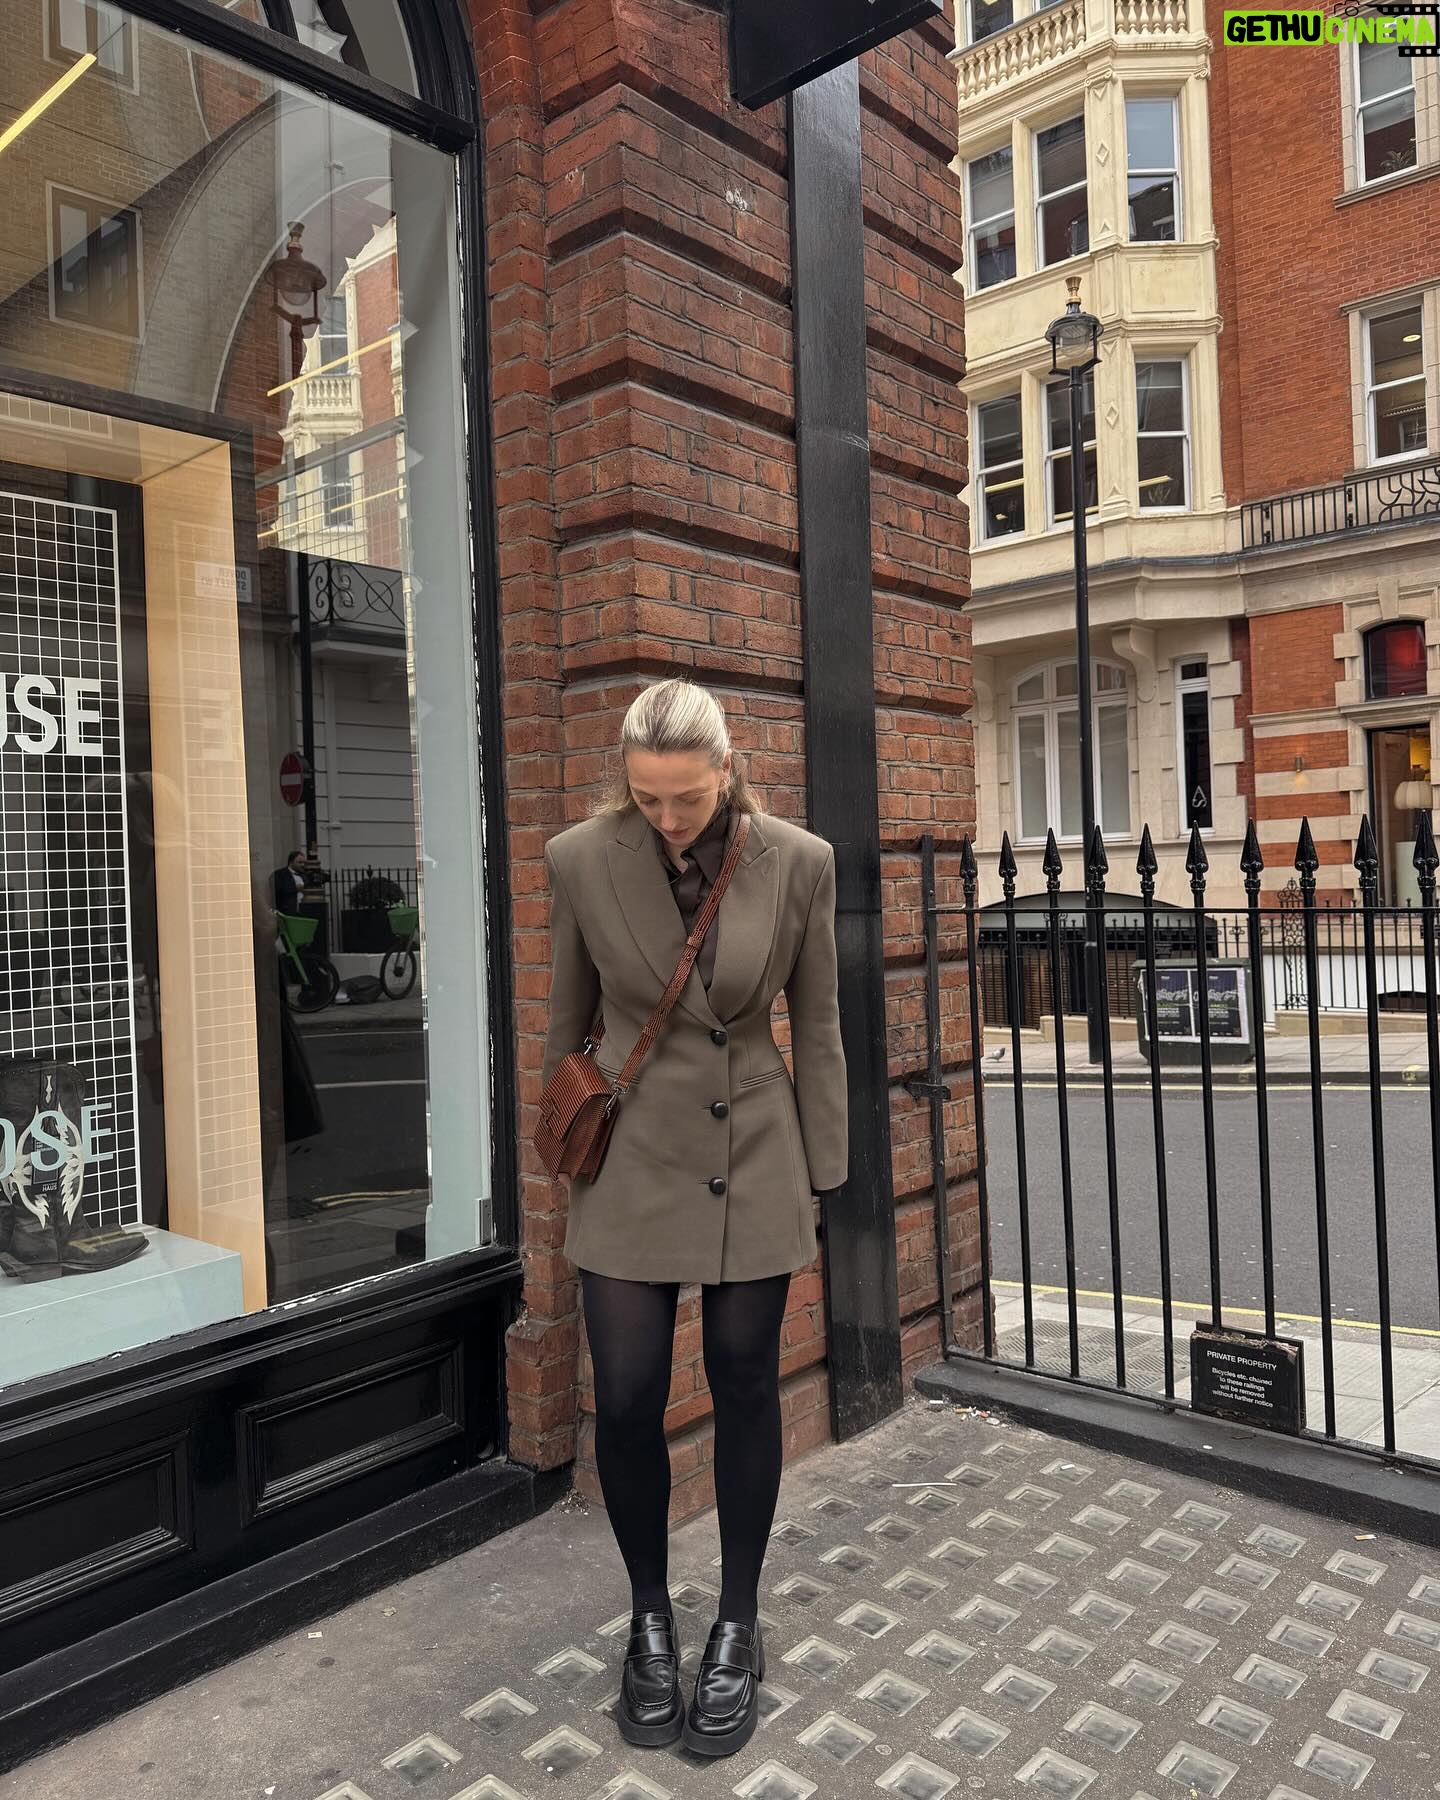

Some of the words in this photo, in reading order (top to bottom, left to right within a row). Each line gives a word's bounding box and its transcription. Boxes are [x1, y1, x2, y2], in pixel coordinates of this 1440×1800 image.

[0, 673, 103, 756] SE
[1206, 1350, 1236, 1363] PRIVATE
[1237, 1356, 1277, 1371] PROPERTY
[1211, 1367, 1236, 1378] Bicycles
[1248, 1376, 1273, 1386] chained
[1226, 1378, 1243, 1387] these
[1243, 1382, 1265, 1392] railings
[1212, 1389, 1234, 1399] without
[1234, 1393, 1254, 1404] further
[1254, 1399, 1274, 1408] notice
[1239, 1388, 1265, 1399] removed
